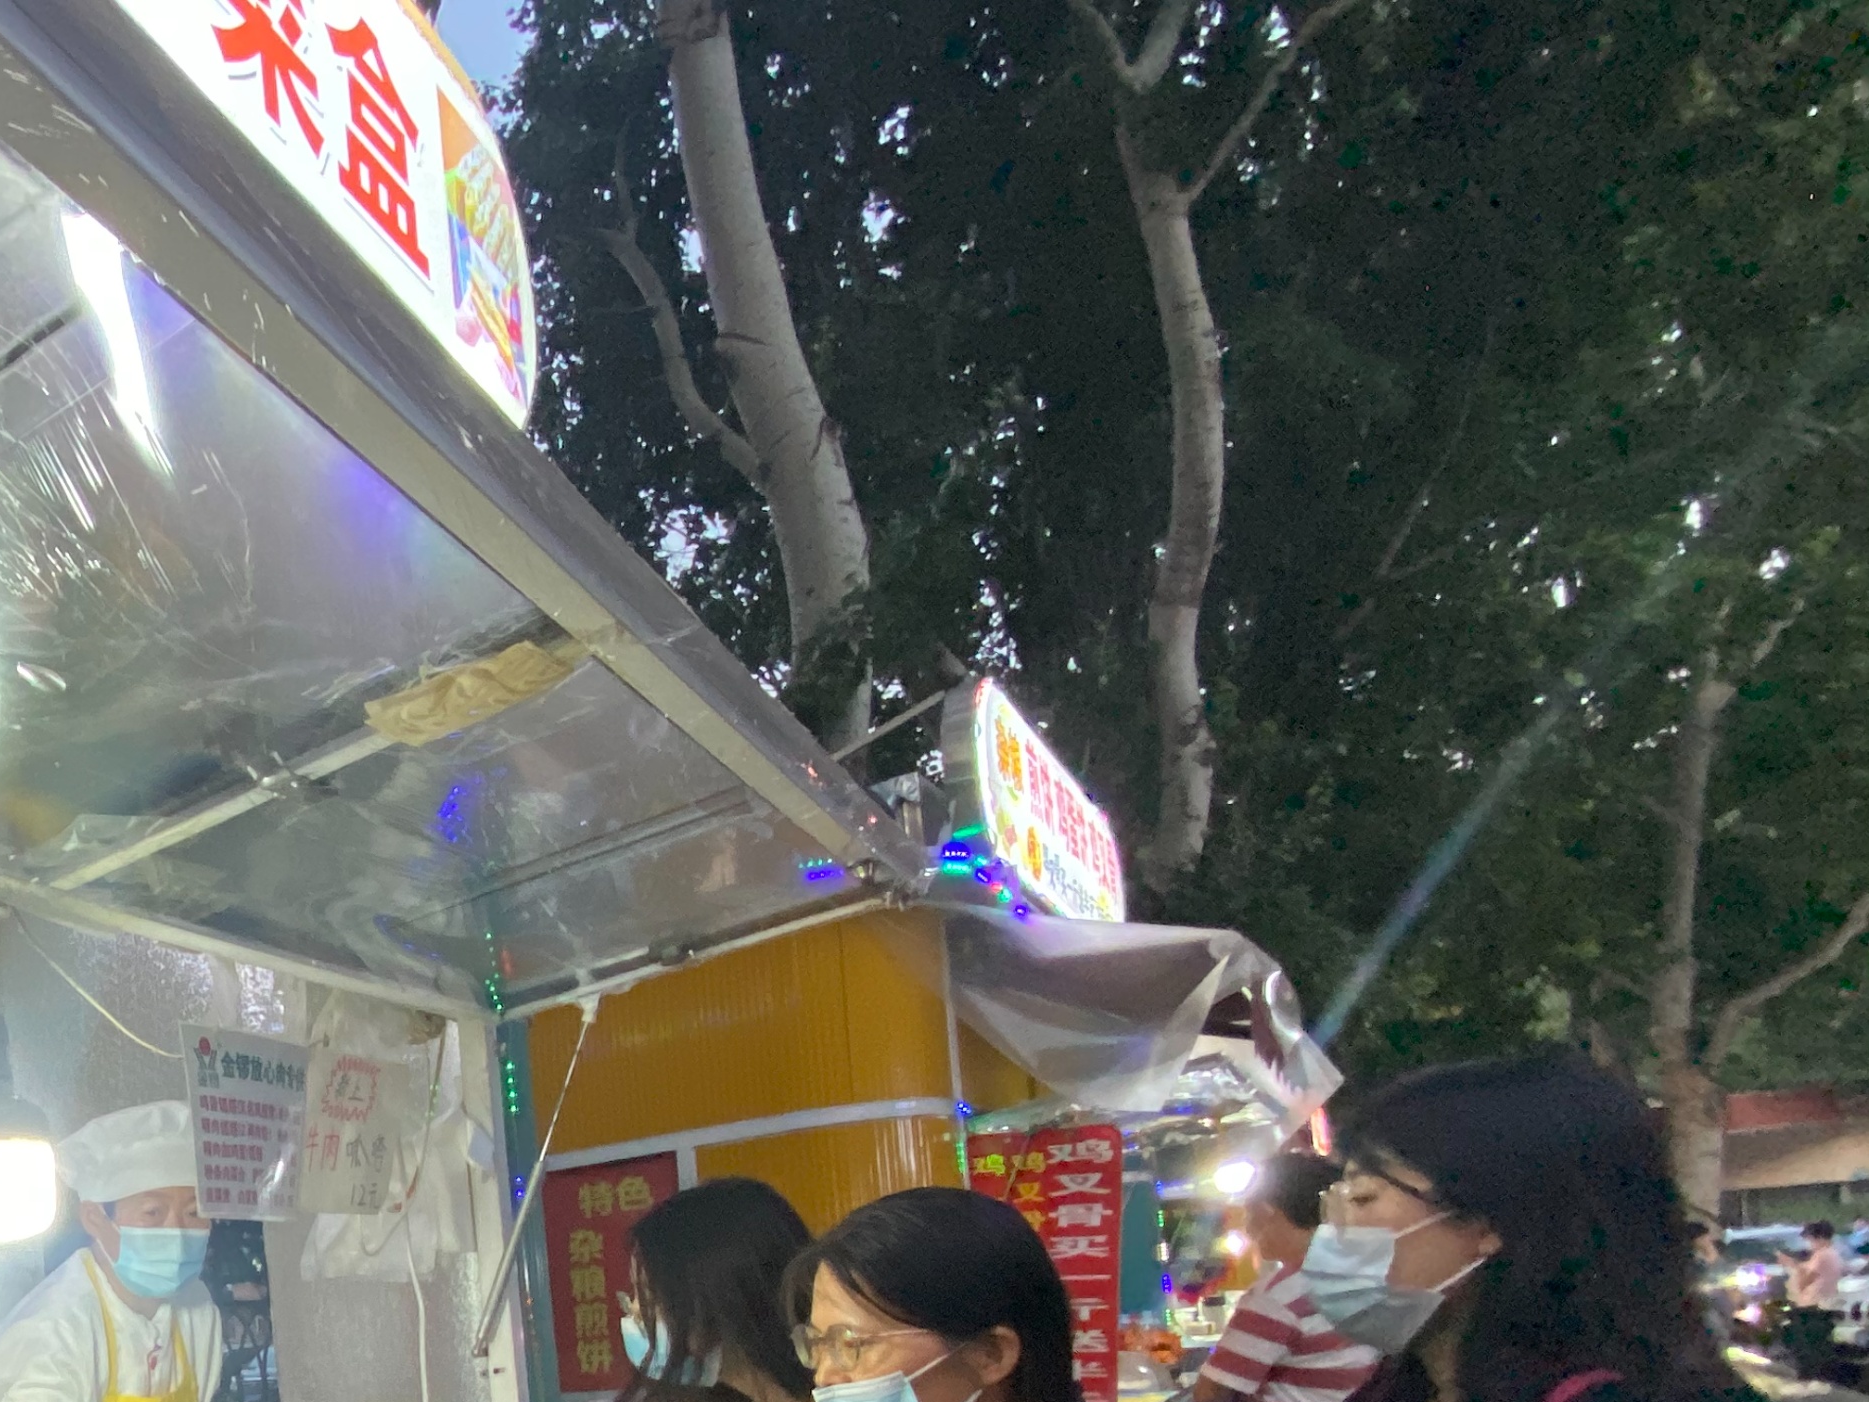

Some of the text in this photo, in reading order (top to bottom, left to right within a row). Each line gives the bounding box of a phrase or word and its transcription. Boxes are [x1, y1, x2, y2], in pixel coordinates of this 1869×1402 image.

[579, 1175, 654, 1219] 特色
[569, 1228, 614, 1375] 杂粮煎饼
